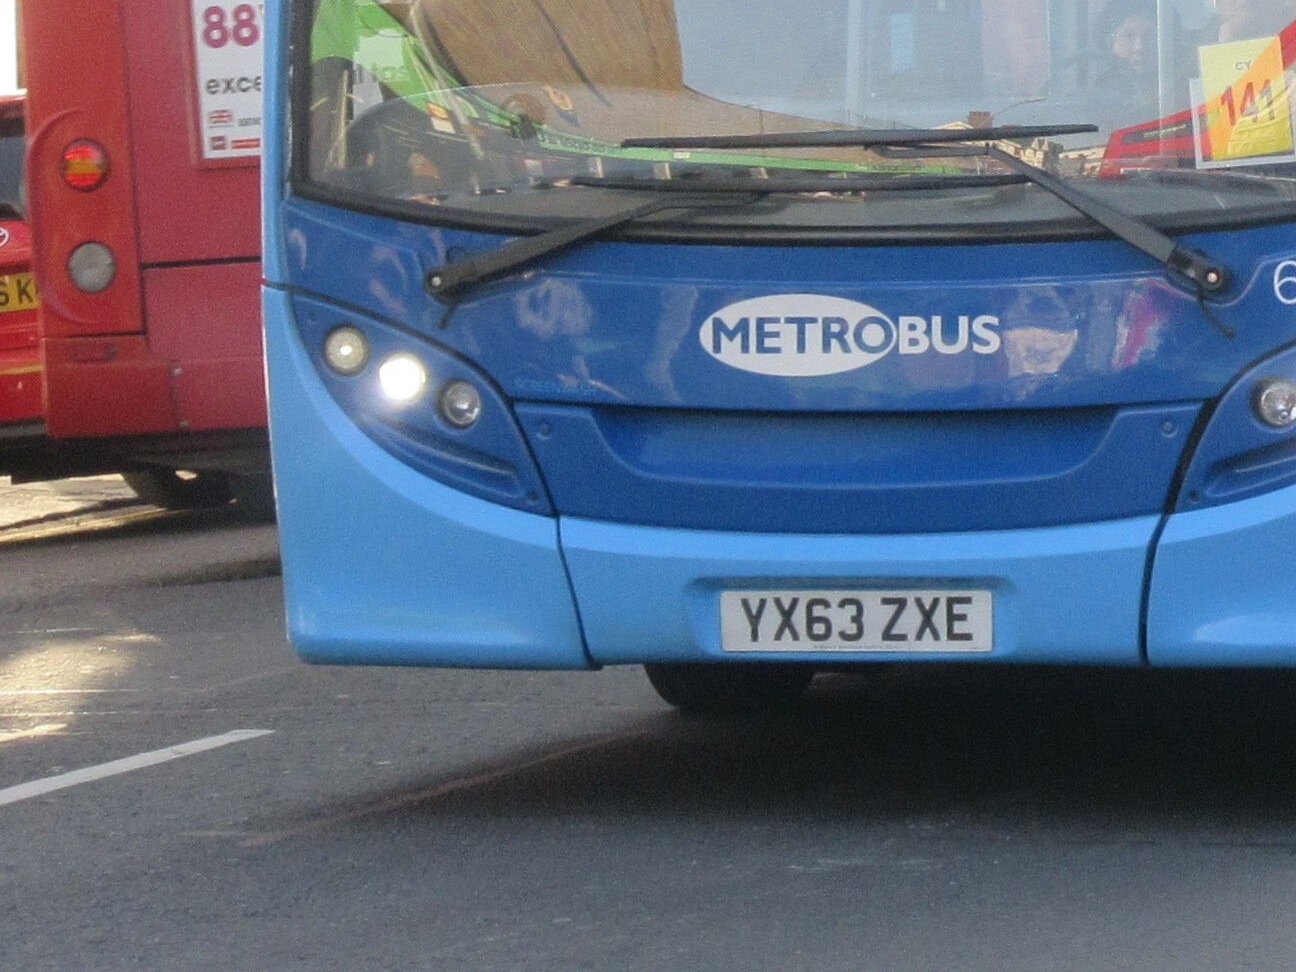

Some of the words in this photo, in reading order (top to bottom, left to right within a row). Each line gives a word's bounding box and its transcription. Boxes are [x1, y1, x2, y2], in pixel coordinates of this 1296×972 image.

[203, 4, 264, 49] 88
[207, 75, 261, 96] exce
[1221, 79, 1276, 126] 141
[741, 596, 865, 642] YX63
[880, 596, 973, 641] ZXE
